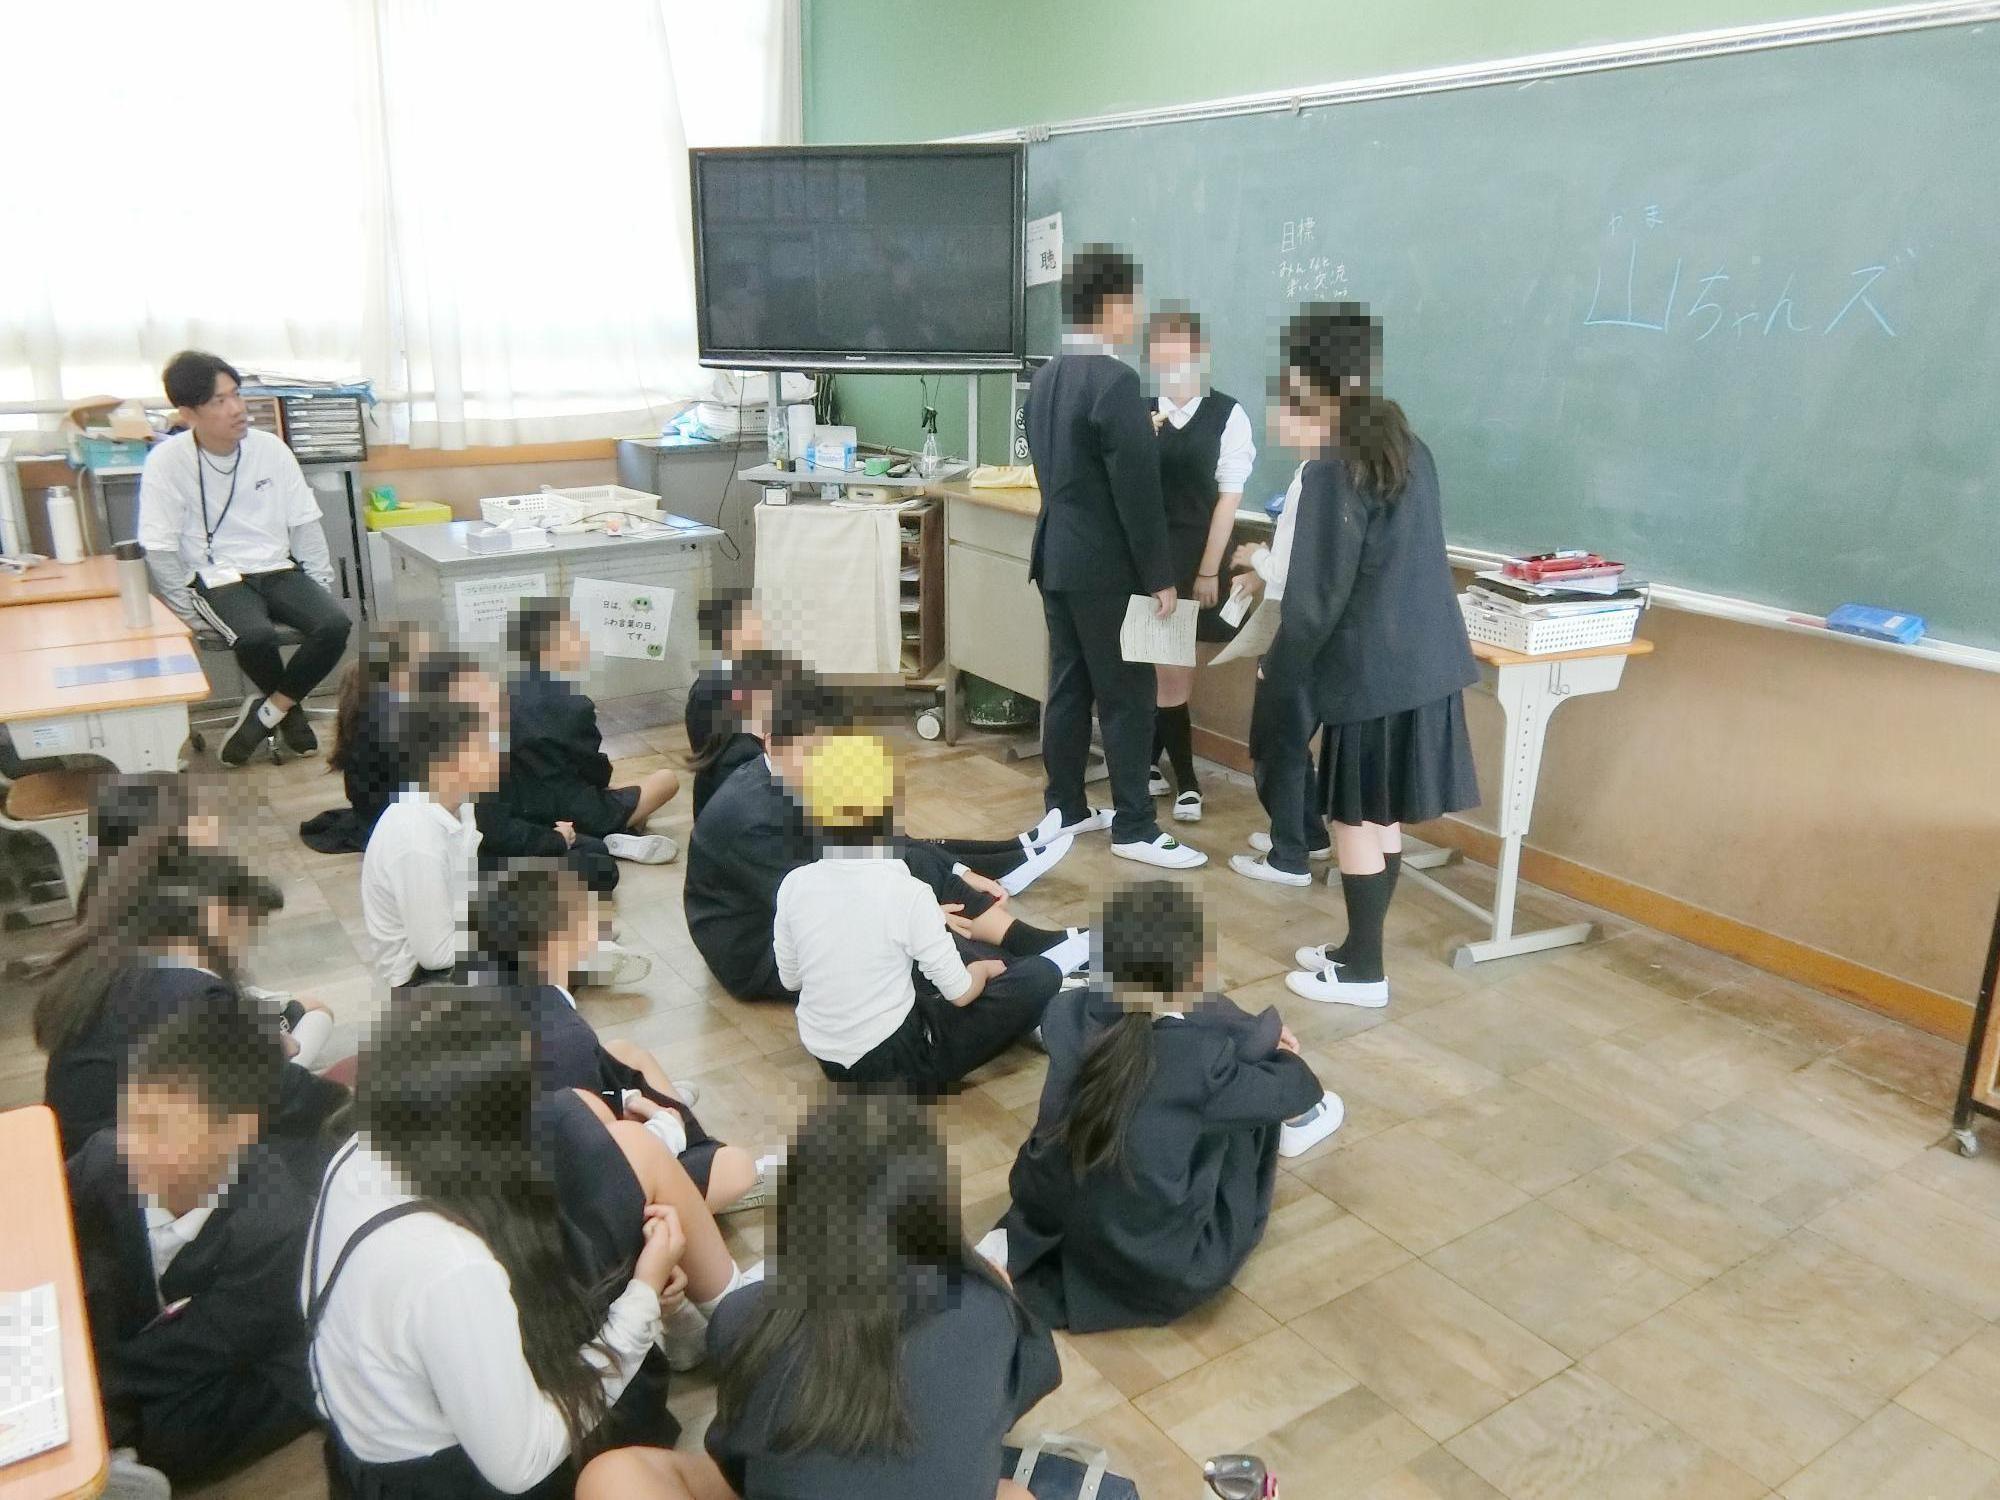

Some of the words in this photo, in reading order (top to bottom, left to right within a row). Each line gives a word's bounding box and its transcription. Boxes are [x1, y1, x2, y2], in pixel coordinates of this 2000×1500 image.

[1280, 216, 1316, 253] 目標
[1039, 248, 1057, 270] 聴
[1583, 239, 1917, 341] 山ちゃんズ
